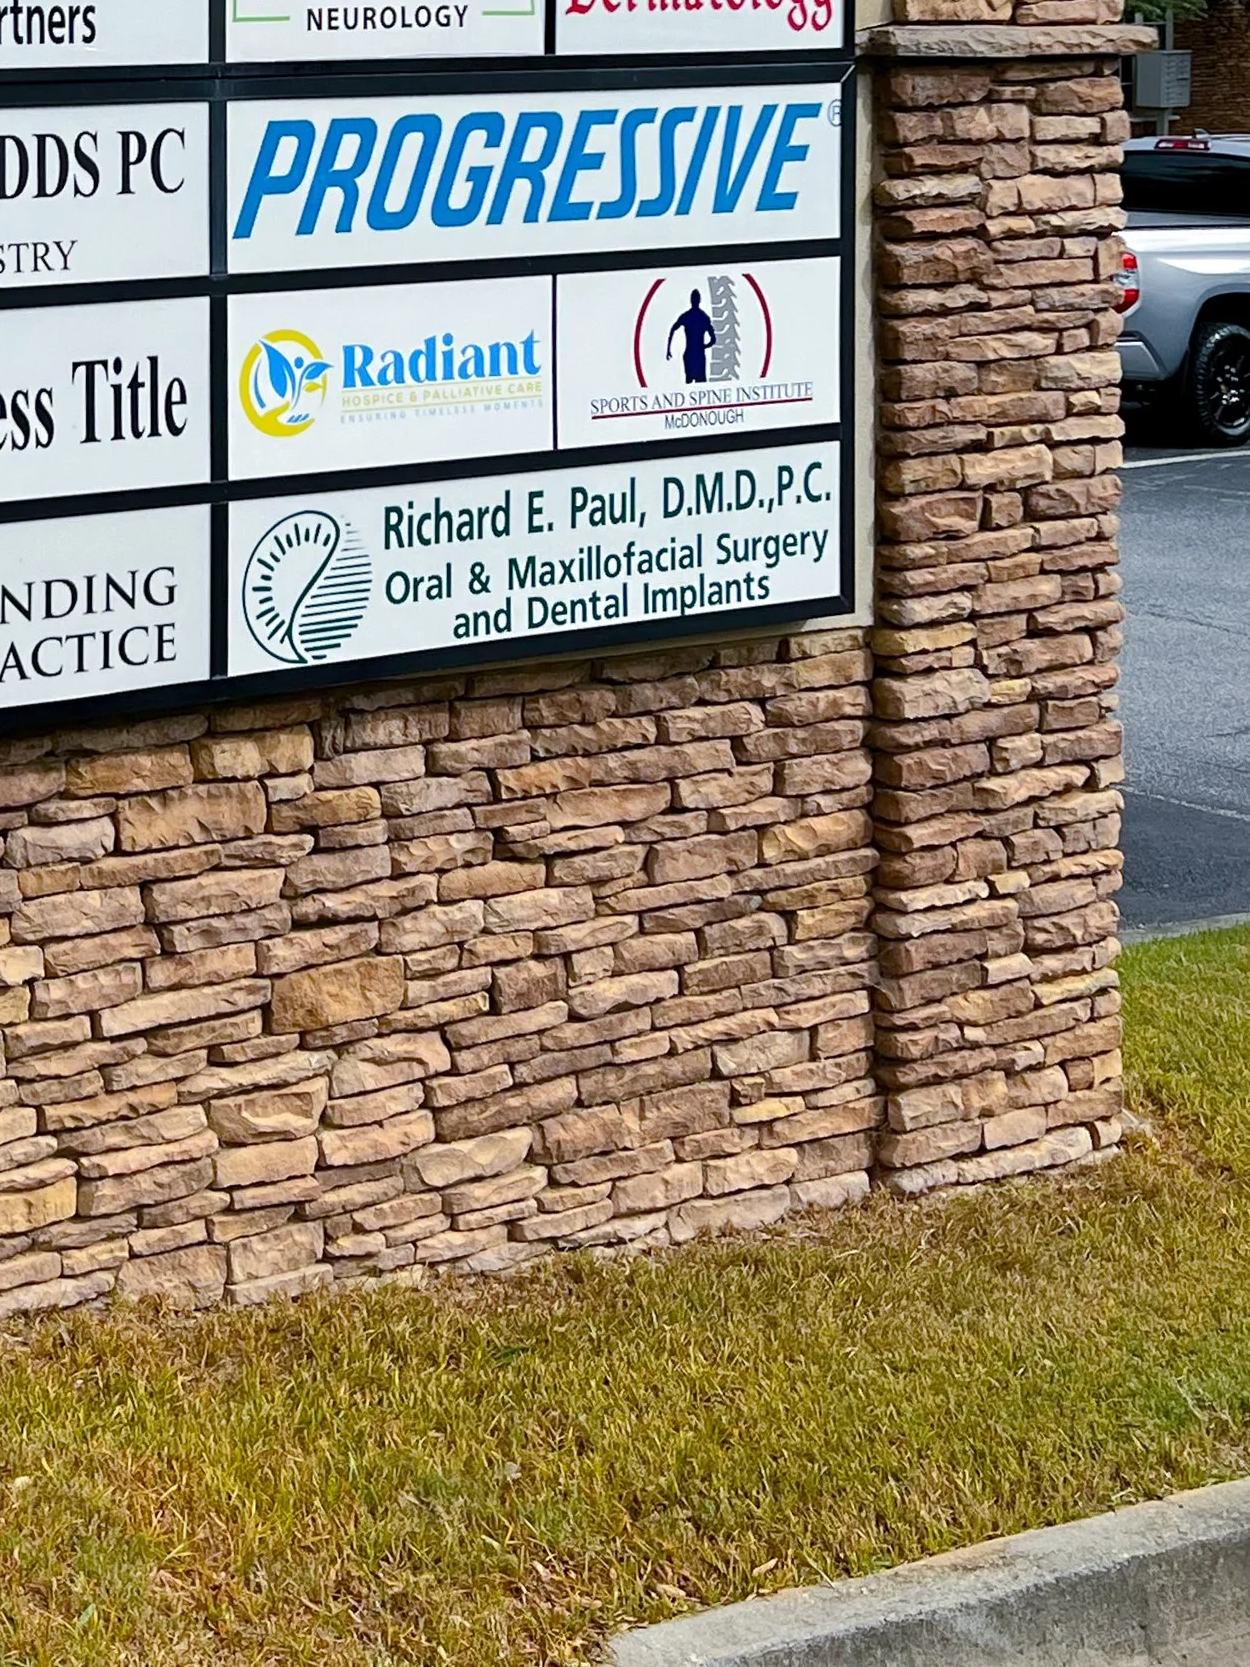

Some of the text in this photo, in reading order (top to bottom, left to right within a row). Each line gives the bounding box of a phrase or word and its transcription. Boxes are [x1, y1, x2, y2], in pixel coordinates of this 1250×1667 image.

[307, 5, 468, 31] NEUROLOGY
[117, 128, 184, 194] PC
[343, 330, 541, 388] Radiant
[72, 356, 187, 444] Title
[341, 392, 404, 408] HOSPICE
[423, 385, 503, 402] PALLIATIVE
[508, 381, 543, 395] CARE
[415, 404, 476, 418] TIMELESS
[484, 399, 544, 412] MOMENTS
[590, 382, 813, 415] SPORTS AND SPINE INSTITUTE
[664, 408, 744, 429] McDONOUGH
[385, 490, 510, 550] Richard
[528, 490, 553, 534] E.
[571, 477, 646, 529] Paul,
[386, 527, 829, 604] Oral & Maxillofacial Surgery
[453, 570, 771, 640] and Dental Implants
